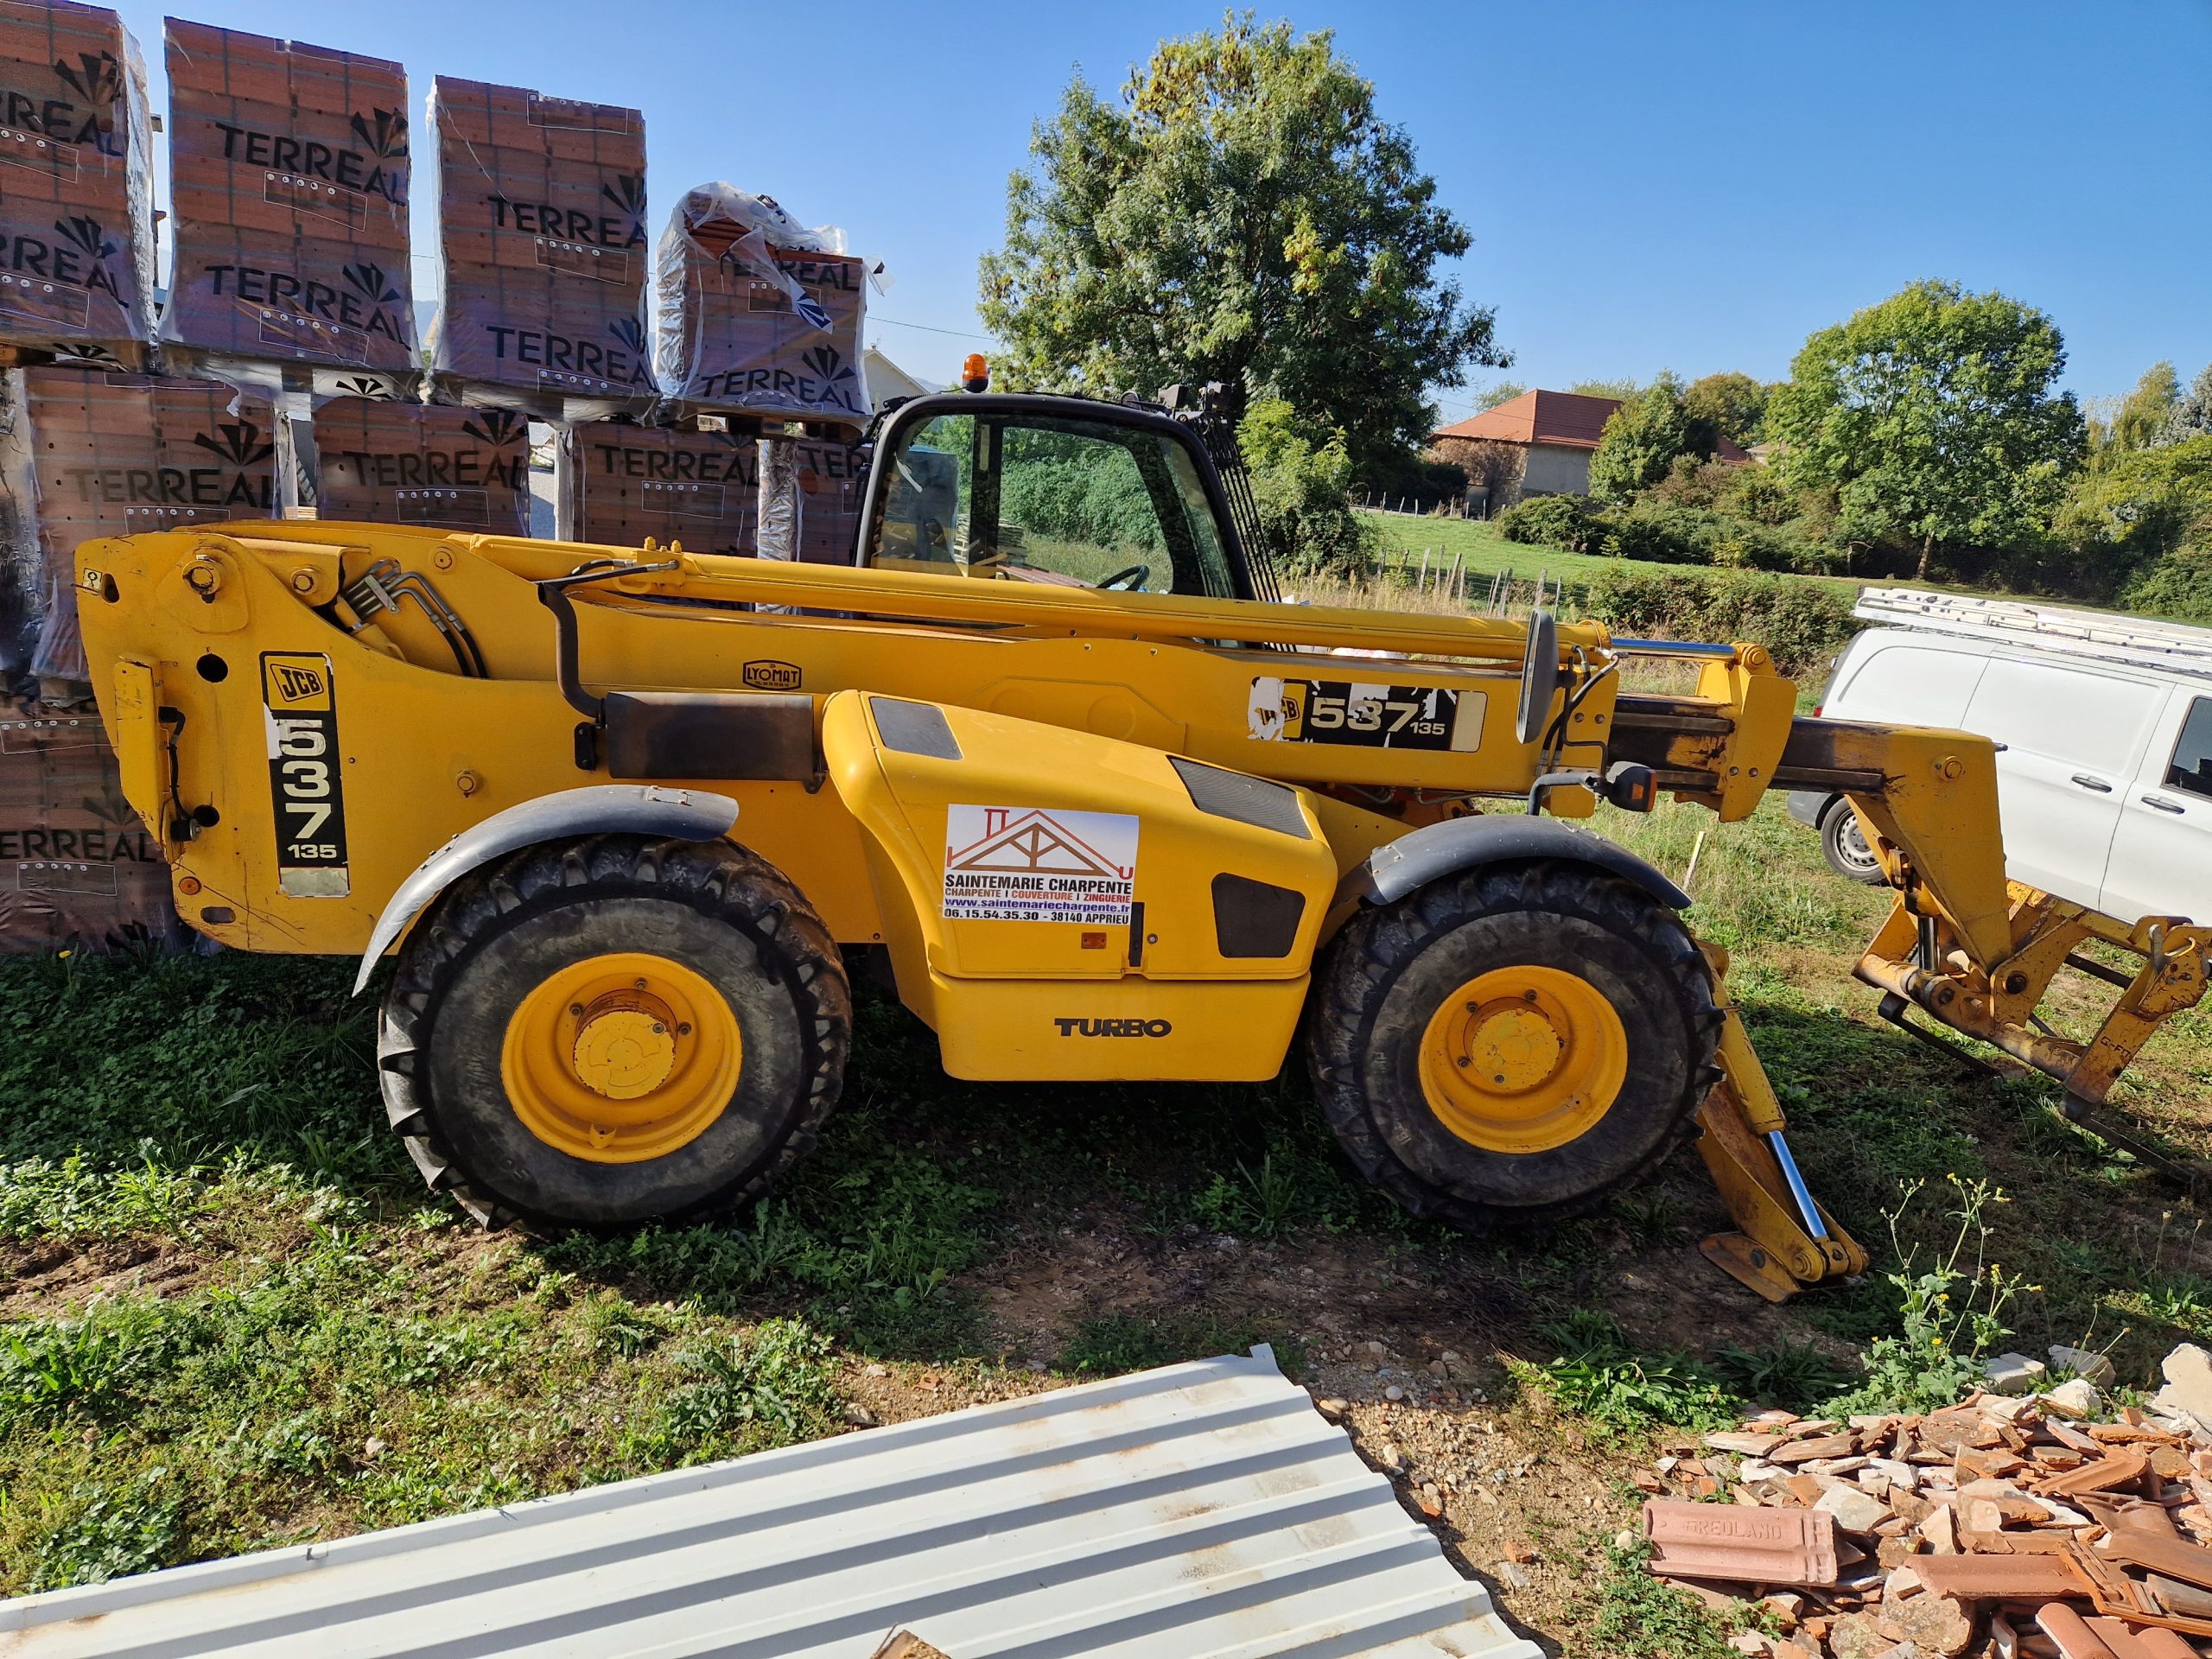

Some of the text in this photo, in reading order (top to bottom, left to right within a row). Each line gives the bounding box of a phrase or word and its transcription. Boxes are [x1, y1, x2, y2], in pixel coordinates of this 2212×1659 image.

[215, 122, 408, 207] TERREAL
[205, 265, 412, 352] TERREAL
[701, 367, 865, 414] TERREAL
[279, 668, 321, 697] JCB
[747, 667, 798, 683] LYOMAT
[1409, 722, 1446, 735] 135
[276, 719, 332, 839] 537
[287, 844, 337, 859] 135
[945, 874, 1132, 895] SAINTEMARIE CHARPENTE
[944, 887, 1001, 898] CHARPENTE
[1011, 890, 1073, 901] COUVERTURE
[1084, 893, 1131, 904] ZINGUERIE
[944, 899, 1131, 913] www.saintemariecharpente.fr
[944, 908, 1039, 920] 06.15.54.35.30
[1051, 912, 1082, 922] 38140
[1085, 913, 1128, 925] APPRIEU
[1054, 1018, 1173, 1038] TURBO
